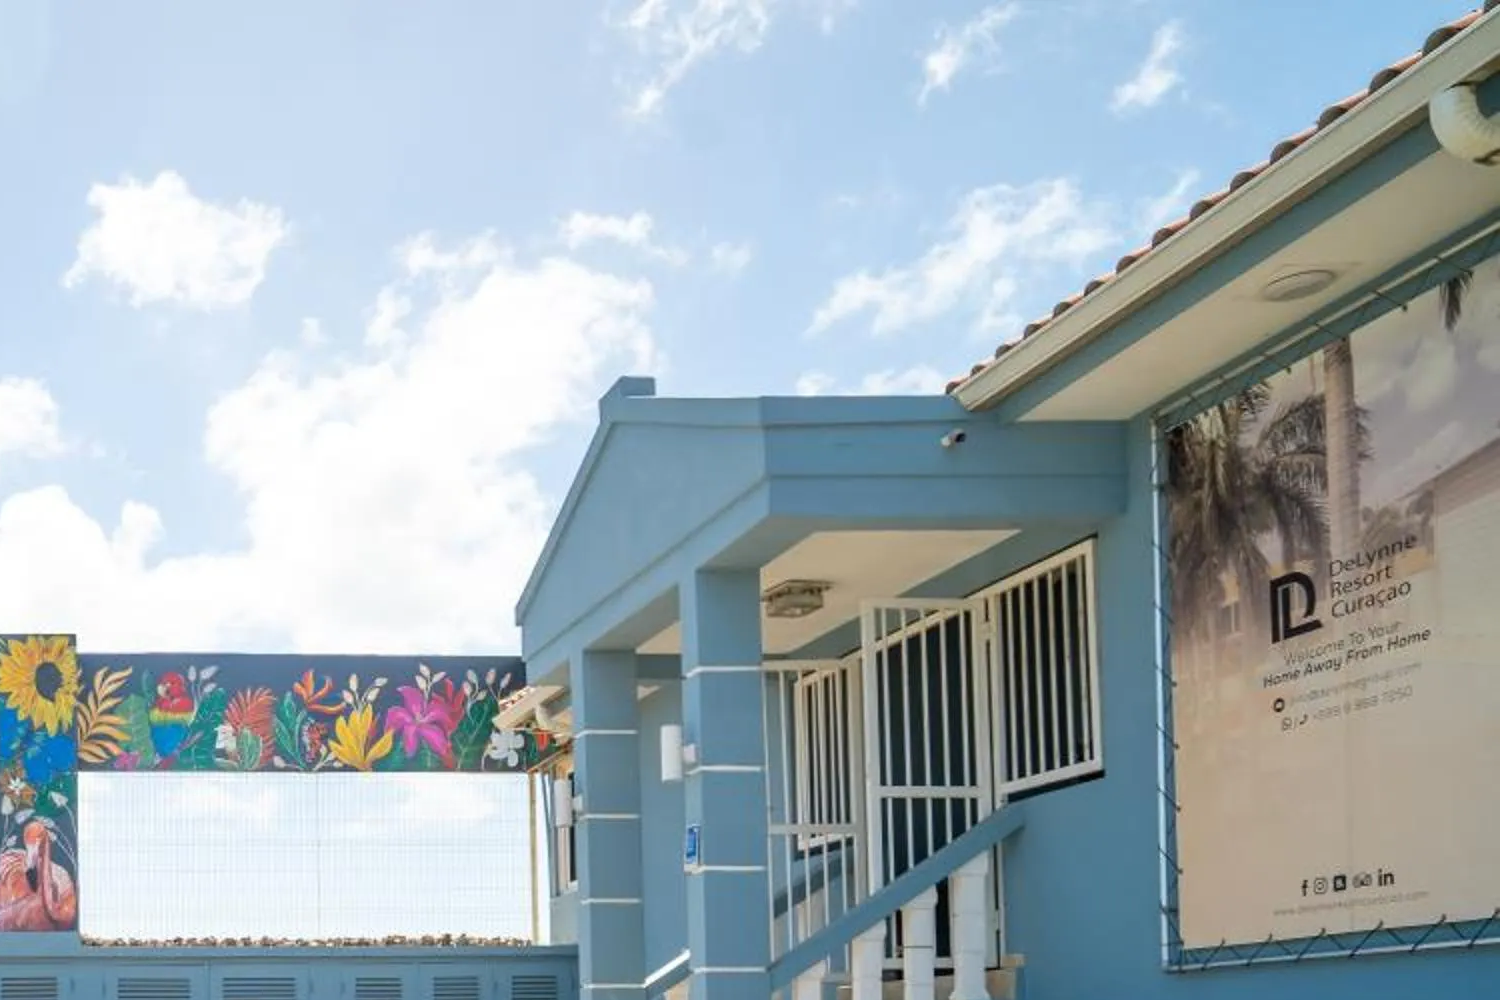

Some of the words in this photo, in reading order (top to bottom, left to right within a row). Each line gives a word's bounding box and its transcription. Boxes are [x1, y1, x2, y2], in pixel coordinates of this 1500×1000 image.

[1329, 535, 1418, 577] DeLynne
[1331, 565, 1393, 598] Resort
[1331, 581, 1412, 618] Curaçao
[1263, 668, 1301, 688] Home
[1303, 656, 1342, 676] Away
[1346, 645, 1383, 664] From
[1387, 629, 1432, 653] Home
[1283, 638, 1345, 666] Welcome
[1349, 632, 1365, 646] To
[1367, 621, 1402, 640] Your
